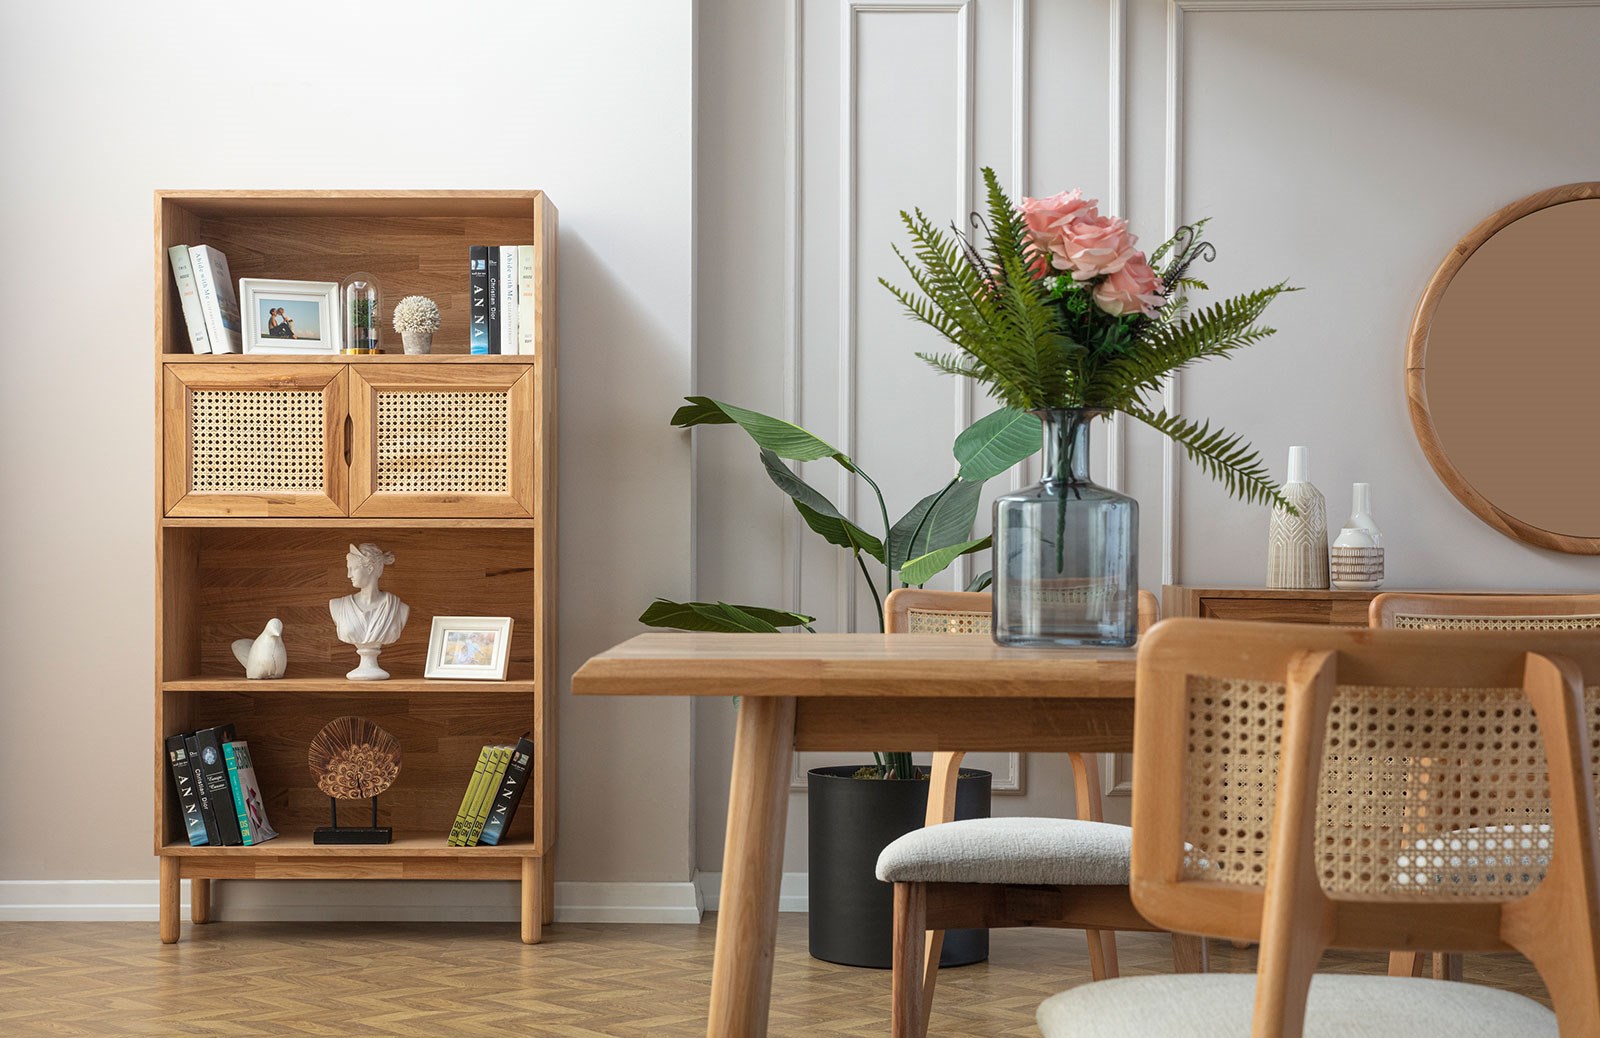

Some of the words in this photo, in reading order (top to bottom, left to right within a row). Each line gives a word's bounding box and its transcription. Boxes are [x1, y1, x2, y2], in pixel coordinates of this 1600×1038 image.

[195, 253, 204, 272] Abide
[204, 290, 211, 300] Me
[507, 290, 513, 300] Me
[473, 285, 485, 337] ANNA
[195, 768, 205, 796] Christian
[201, 797, 209, 810] Dior
[178, 775, 199, 827] ANNA
[490, 775, 517, 825] ANNA
[240, 820, 248, 828] DS
[454, 820, 463, 829] DS
[464, 820, 472, 829] DS
[474, 820, 483, 828] DS
[451, 829, 459, 838] GN
[460, 829, 469, 837] GN
[472, 829, 480, 837] GN
